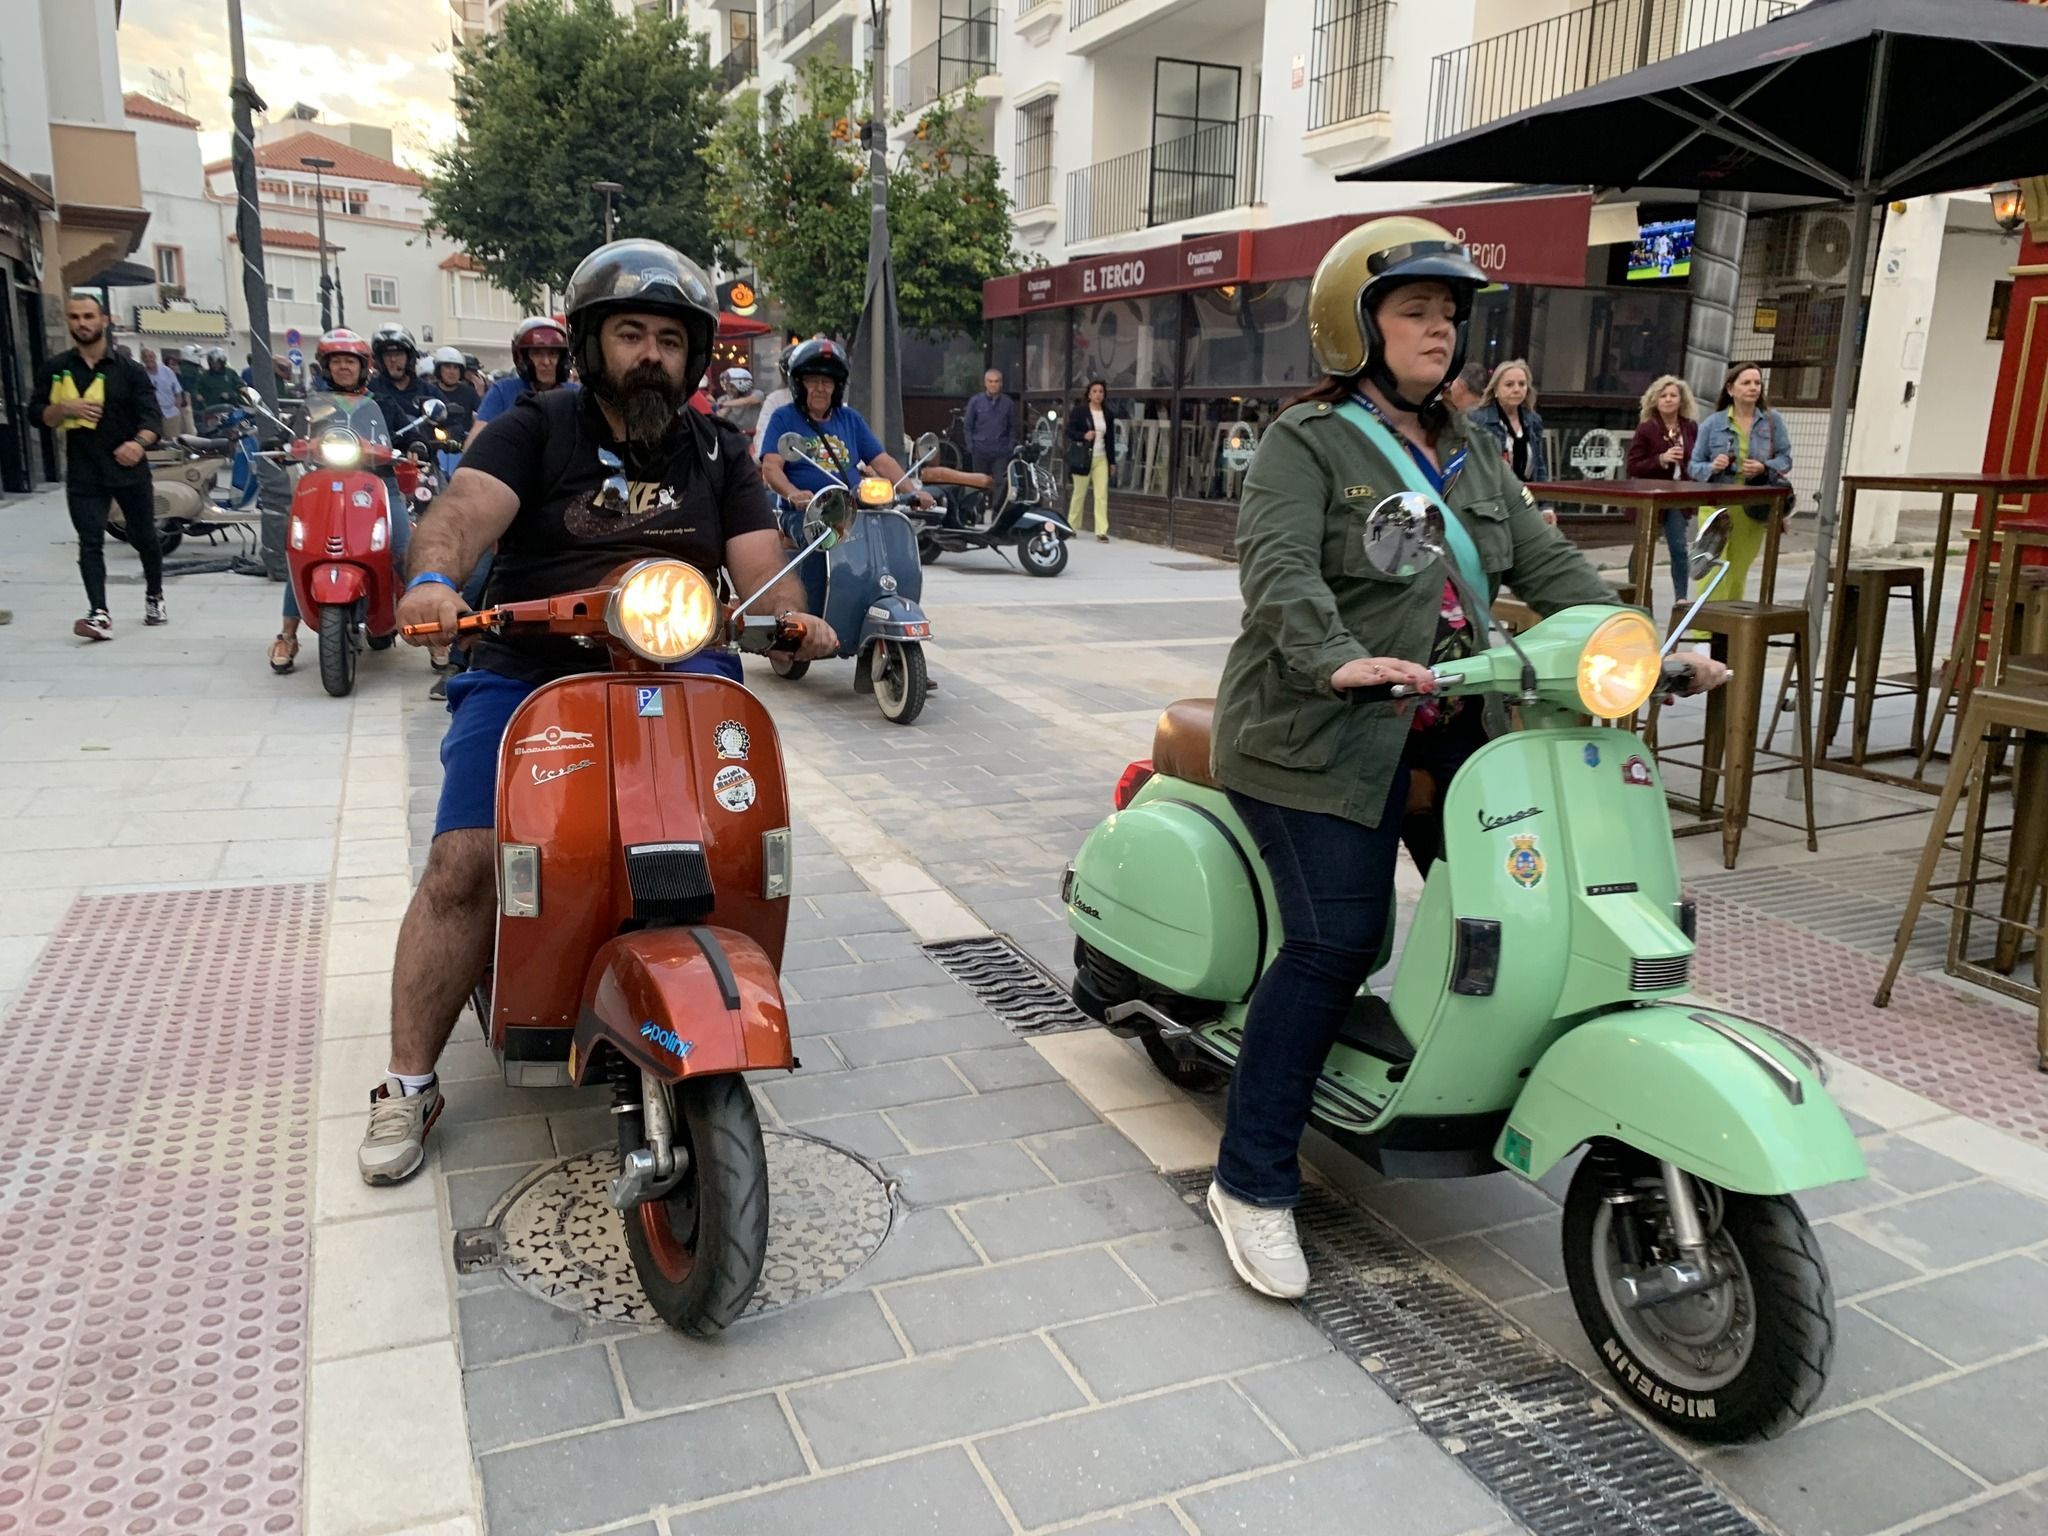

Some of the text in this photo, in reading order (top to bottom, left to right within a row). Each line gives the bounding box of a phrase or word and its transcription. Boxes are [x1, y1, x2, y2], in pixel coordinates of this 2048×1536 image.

[1083, 259, 1145, 293] EL TERCIO
[1478, 806, 1544, 833] Vespa
[649, 1023, 694, 1058] polini
[1602, 1337, 1717, 1418] MICHELIN
